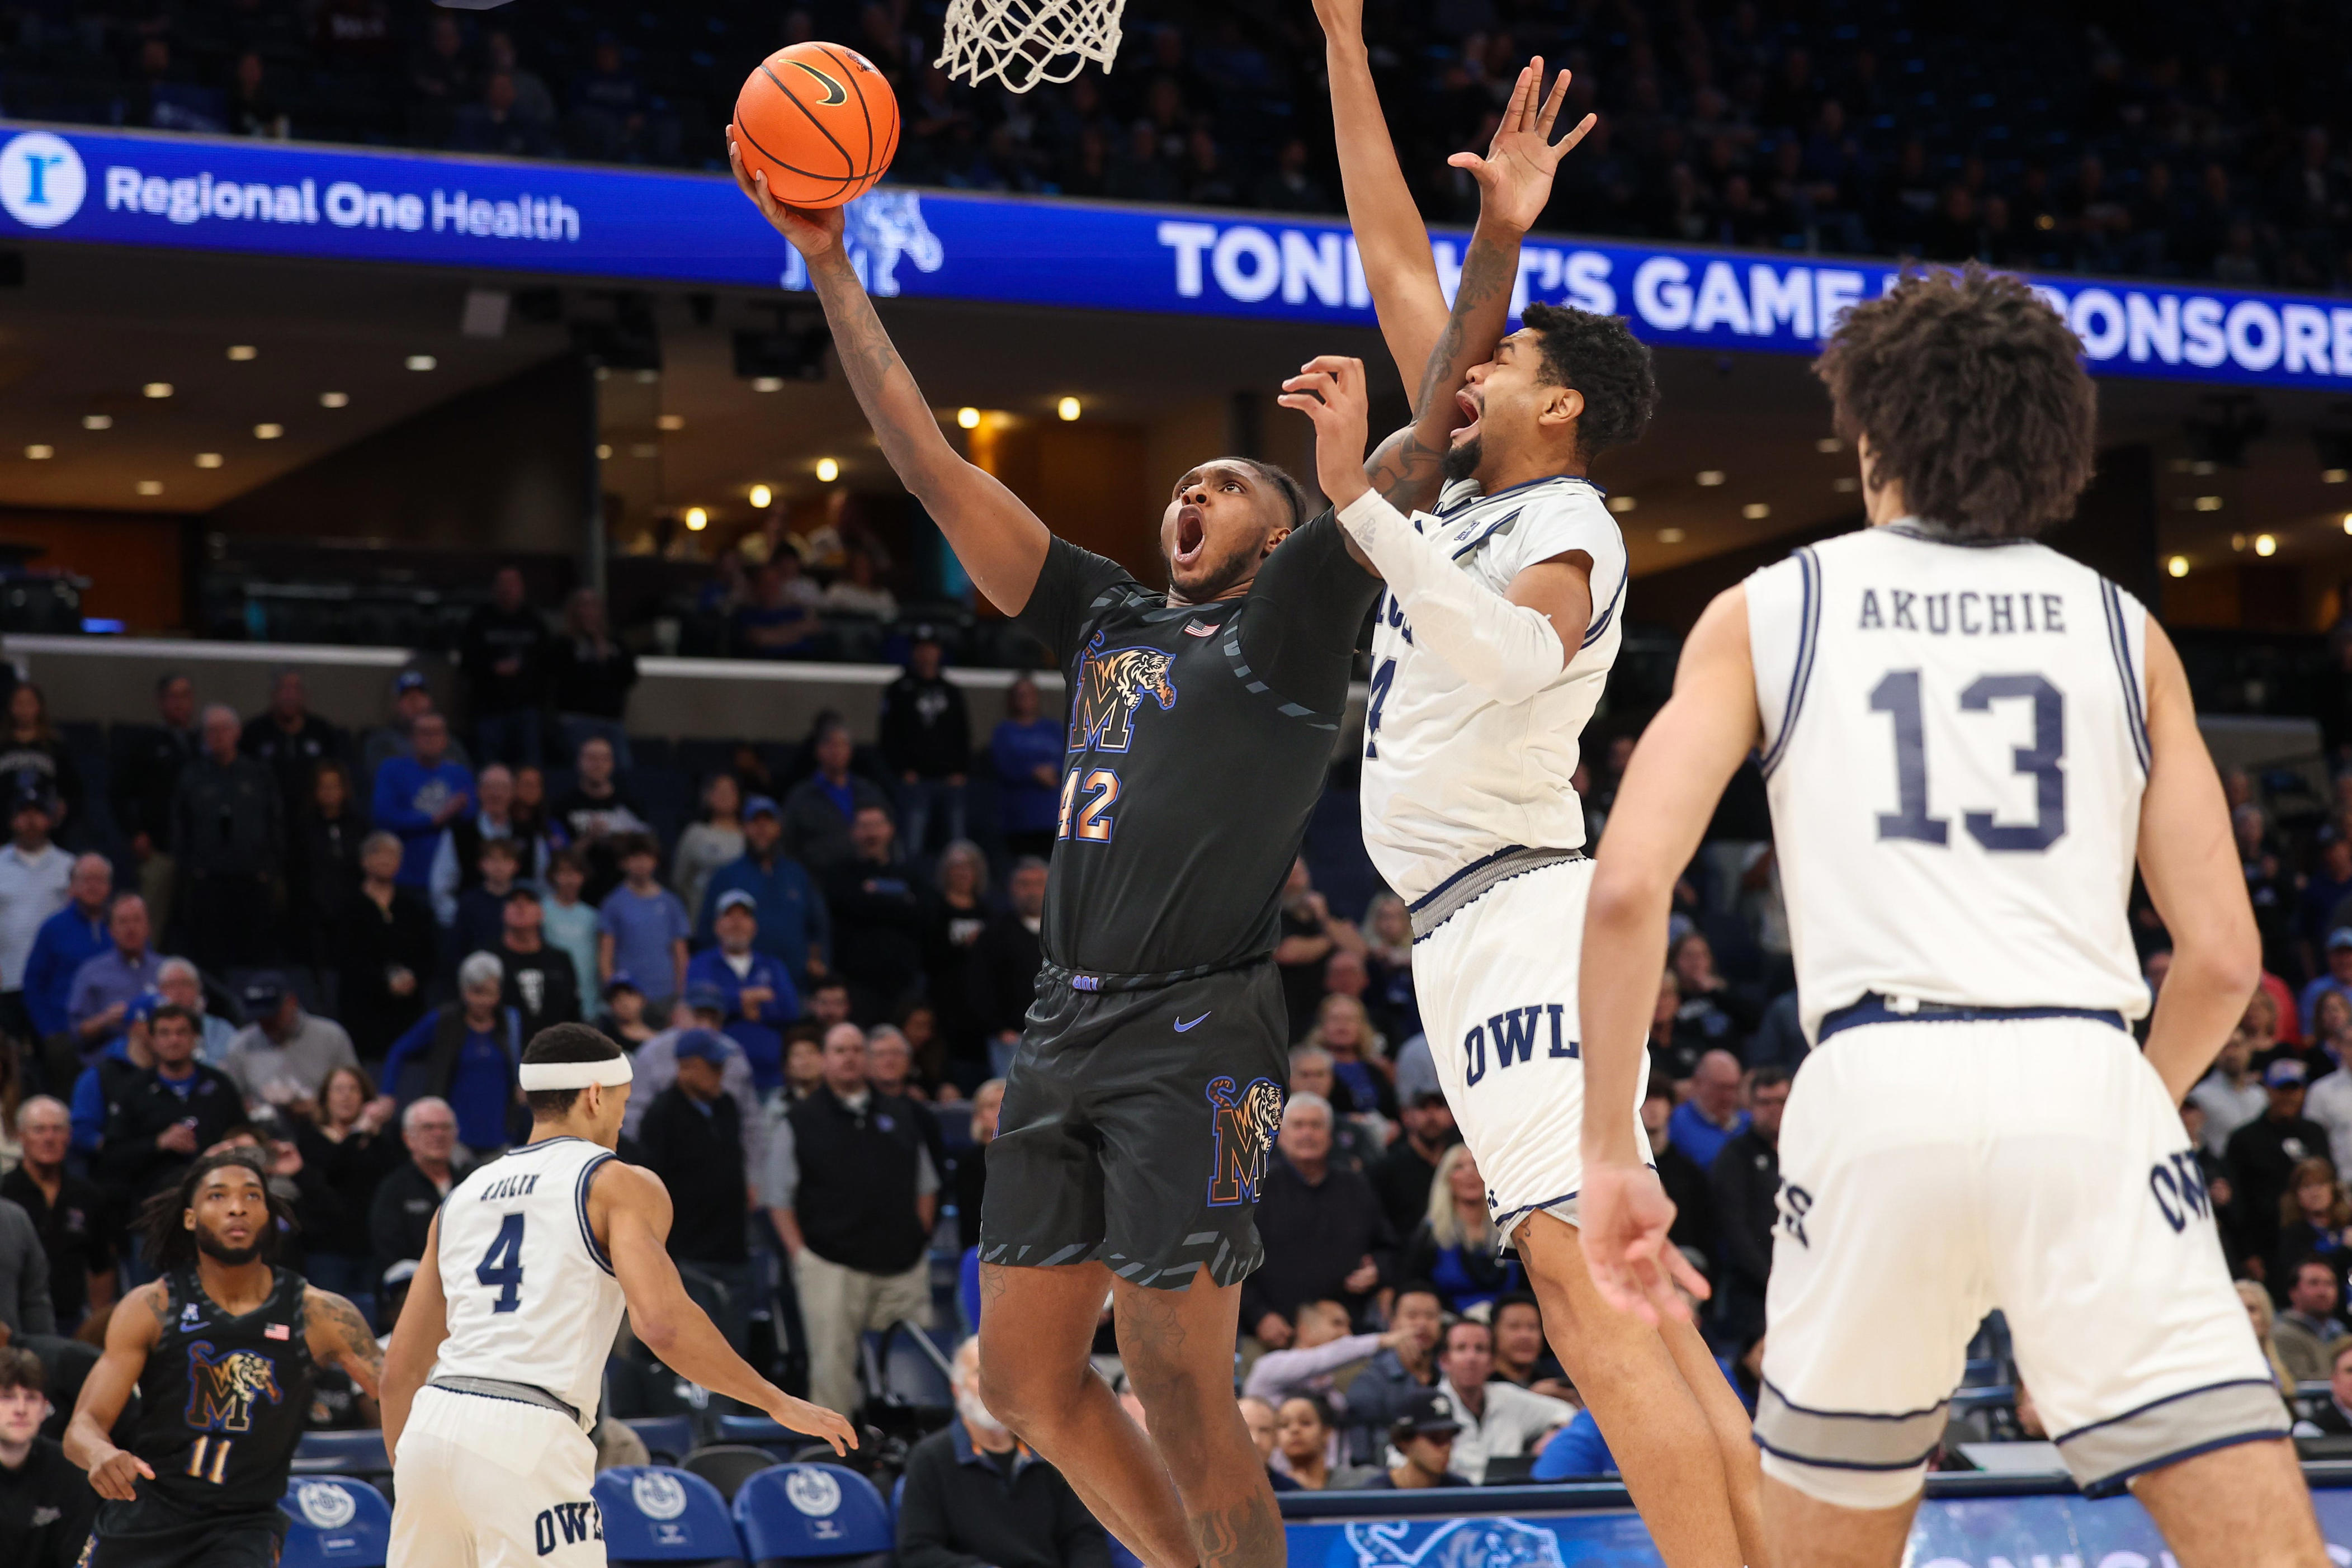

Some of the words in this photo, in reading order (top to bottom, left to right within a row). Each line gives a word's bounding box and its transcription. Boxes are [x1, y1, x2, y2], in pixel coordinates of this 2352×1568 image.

[106, 166, 319, 224] Regional
[325, 181, 424, 232] One
[431, 188, 580, 241] Health
[1158, 221, 1618, 317] TONIT'S
[1633, 255, 1864, 340] GAME
[1858, 588, 2067, 636] AKUCHIE
[1364, 653, 1397, 761] 4
[1867, 666, 2069, 853] 13
[1058, 767, 1121, 843] 42
[475, 1211, 525, 1315] 4
[186, 1433, 234, 1486] 11
